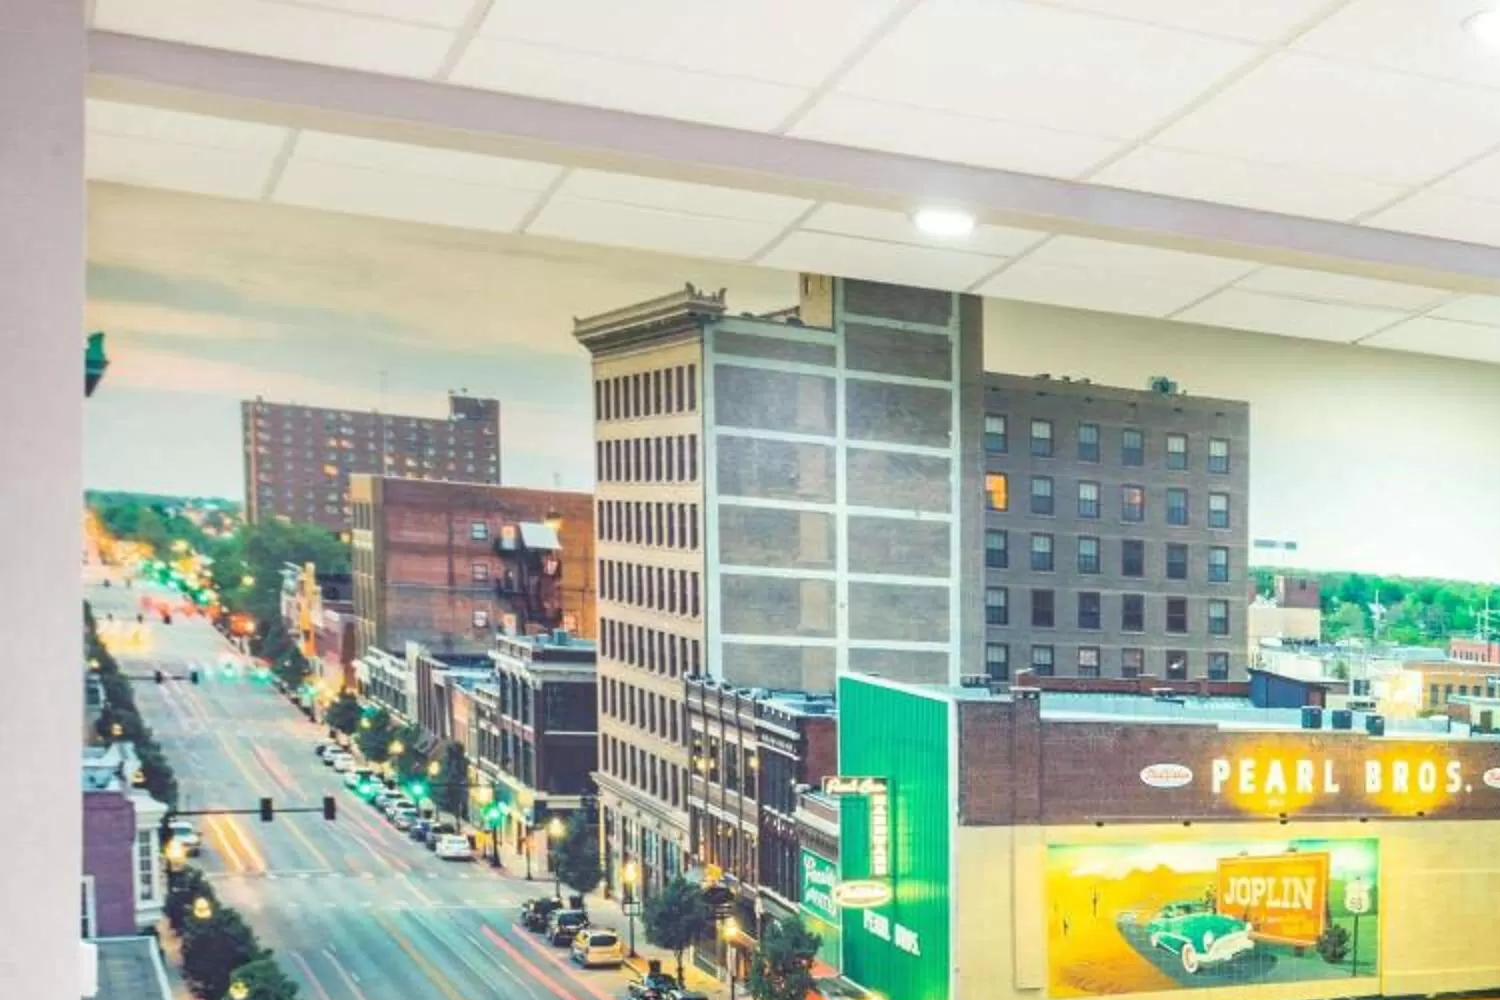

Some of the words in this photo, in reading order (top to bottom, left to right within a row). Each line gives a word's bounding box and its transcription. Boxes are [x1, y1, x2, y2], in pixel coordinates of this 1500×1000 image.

[1211, 759, 1340, 794] PEARL
[1364, 760, 1473, 794] BROS.
[1223, 875, 1316, 910] JOPLIN
